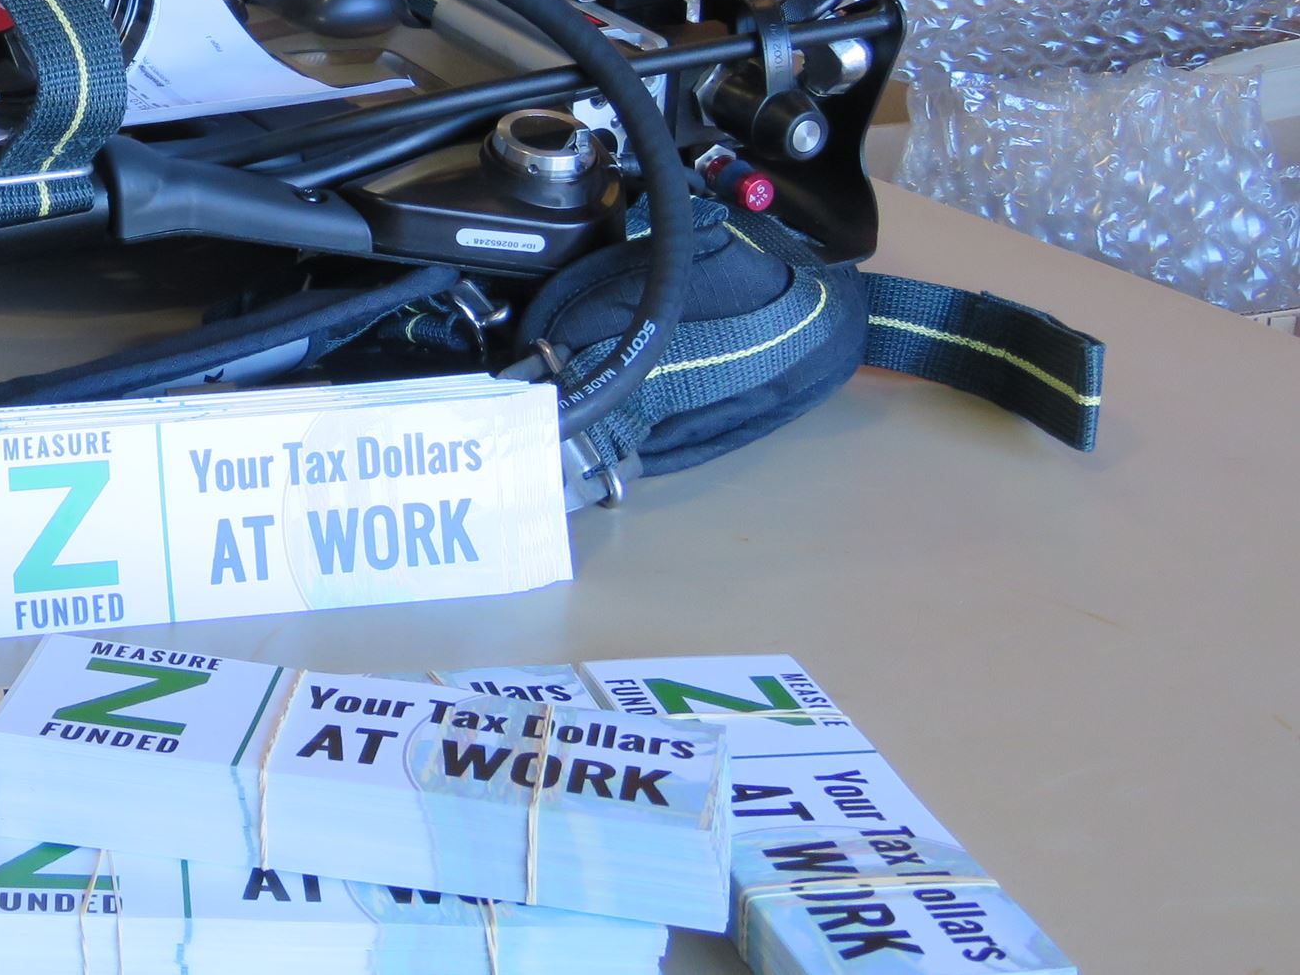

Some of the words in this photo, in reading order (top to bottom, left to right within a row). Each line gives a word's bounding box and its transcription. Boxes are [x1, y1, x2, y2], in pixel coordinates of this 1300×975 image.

[748, 184, 766, 203] 4.5
[620, 319, 656, 367] SCOTT
[568, 390, 585, 404] IN
[582, 368, 617, 395] MADE
[558, 399, 570, 409] U
[3, 431, 112, 461] MEASURE
[189, 448, 274, 493] Your
[283, 441, 347, 486] Tax
[356, 432, 483, 480] Dollars
[8, 459, 120, 594] Z
[210, 514, 275, 585] AT
[307, 498, 480, 575] WORK
[14, 592, 125, 630] FUNDED
[90, 641, 223, 671] MEASURE
[52, 657, 212, 736] Z
[604, 679, 658, 715] FUND
[643, 675, 817, 727] Z
[39, 721, 180, 754] FUNDED
[308, 685, 415, 719] Your
[429, 699, 509, 734] Tax
[522, 713, 696, 760] Dollars
[296, 724, 398, 765] AT
[443, 740, 673, 807] WORK
[731, 783, 815, 821] AT
[814, 769, 887, 821] Your
[859, 825, 926, 866] Tax
